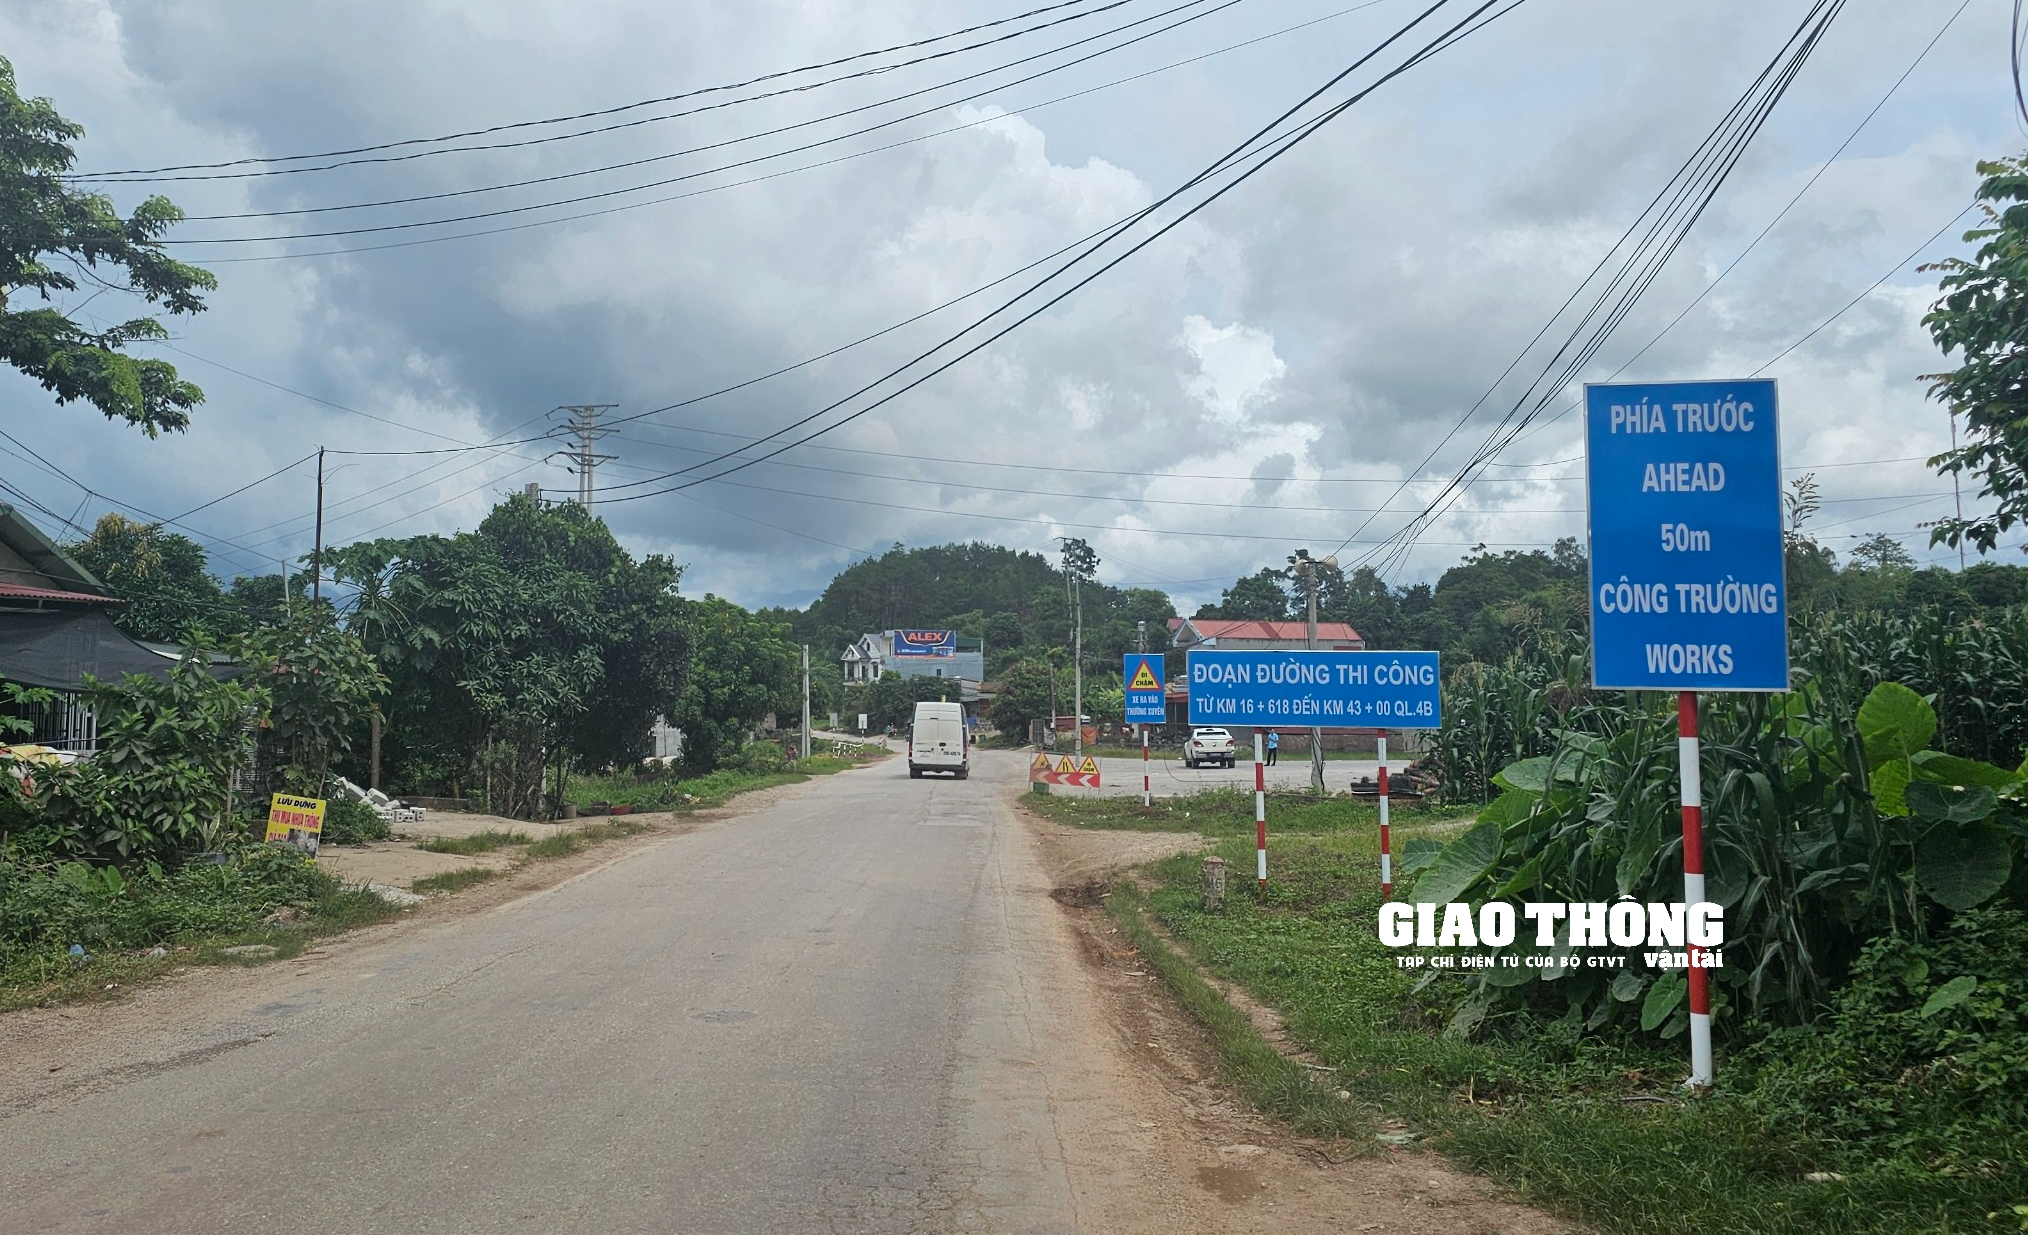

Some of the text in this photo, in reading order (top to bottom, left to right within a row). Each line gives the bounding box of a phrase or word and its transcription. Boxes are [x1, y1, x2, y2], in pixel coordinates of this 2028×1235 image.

[1611, 394, 1754, 434] PHÍA TRƯỚC
[1642, 463, 1725, 492] AHEAD
[1661, 523, 1711, 552] 50m
[1600, 575, 1778, 614] CÔNG TRƯỜNG
[908, 632, 943, 642] ALEX
[1193, 657, 1434, 689] ĐOẠN ĐƯỜNG THI CÔNG
[1646, 644, 1734, 675] WORKS
[1132, 696, 1139, 704] XE
[1196, 694, 1433, 717] TỪ KM 16 + 618 ĐẾN KM 43 + 00 QL.4B
